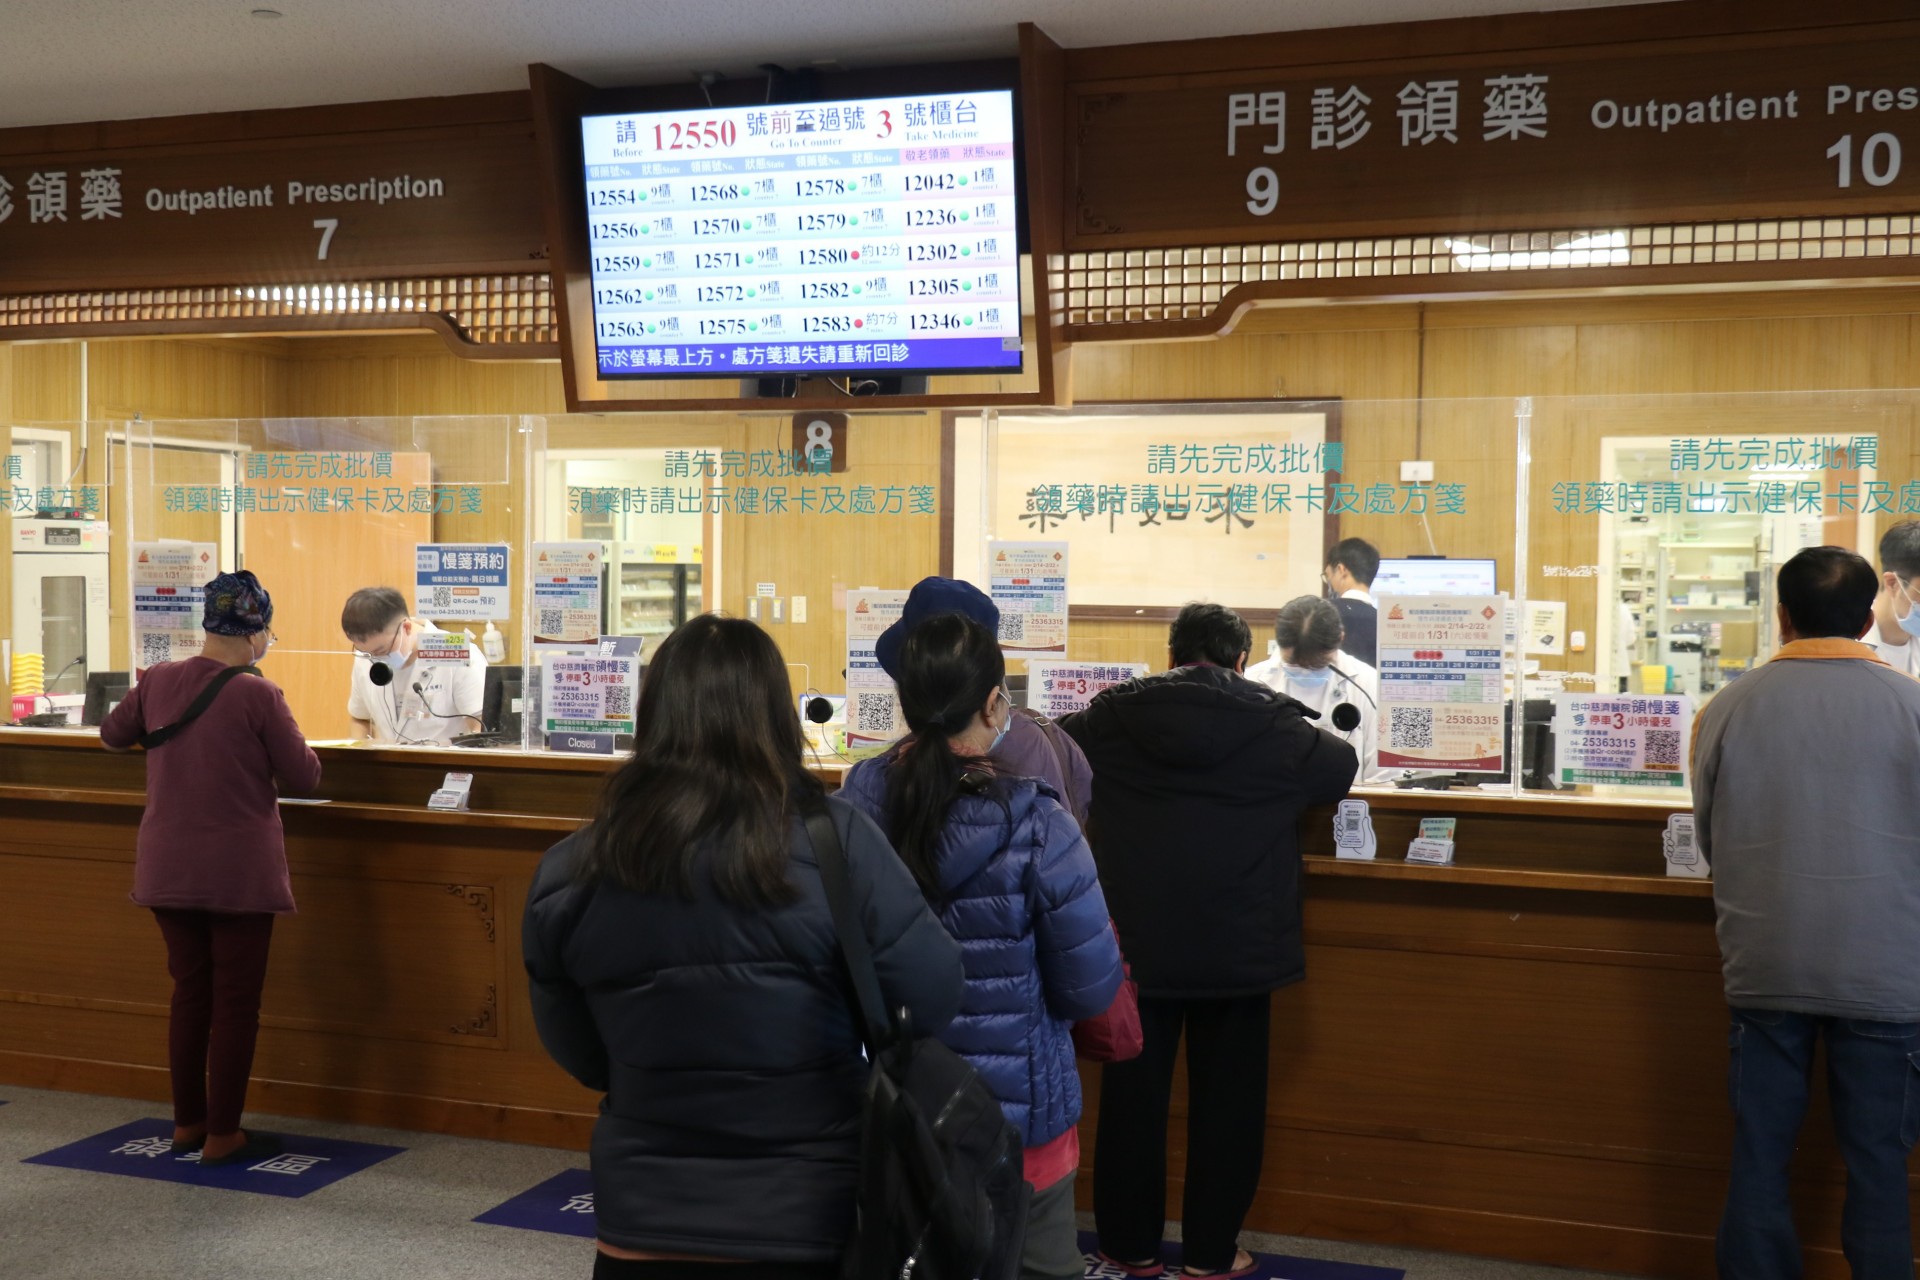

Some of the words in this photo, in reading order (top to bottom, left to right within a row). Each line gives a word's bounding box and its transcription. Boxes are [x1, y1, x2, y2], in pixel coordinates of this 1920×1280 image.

[1227, 73, 1549, 156] 門診領藥
[1590, 89, 1799, 132] Outpatient
[1826, 84, 1918, 115] Pres
[616, 120, 636, 144] 請
[652, 119, 736, 151] 12550
[747, 106, 866, 136] 號前至過號
[876, 110, 892, 138] 3
[904, 99, 977, 127] 號櫃台
[612, 148, 643, 158] Before
[770, 139, 784, 149] Go
[789, 138, 800, 148] To
[802, 137, 842, 148] Counter
[904, 131, 929, 142] Take
[932, 129, 979, 140] Medicine
[904, 148, 950, 161] 敬老領藥
[1826, 132, 1901, 188] 10
[145, 184, 273, 215] Outpatient
[288, 174, 444, 206] Prescription
[590, 189, 636, 206] 12554
[651, 184, 671, 198] 9櫃
[691, 184, 738, 202] 12568
[754, 178, 774, 194] 7櫃
[796, 179, 845, 196] 12578
[862, 173, 883, 188] 7櫃
[905, 174, 955, 191] 12042
[974, 167, 994, 183] 1櫃
[1245, 167, 1280, 216] 9
[592, 223, 638, 239] 12556
[653, 217, 673, 232] 7櫃
[693, 218, 740, 235] 12570
[756, 213, 776, 227] 7櫃
[797, 213, 846, 231] 12579
[863, 208, 884, 223] 7櫃
[906, 209, 956, 226] 12236
[975, 203, 996, 218] 1櫃
[312, 219, 339, 260] 7
[595, 256, 640, 273] 12559
[655, 251, 675, 265] 7櫃
[695, 253, 740, 269] 12571
[758, 247, 778, 261] 9櫃
[799, 248, 847, 265] 12580
[862, 243, 899, 257] 約12分
[907, 244, 957, 261] 12302
[977, 239, 997, 254] 1櫃
[597, 289, 642, 305] 12562
[657, 284, 677, 298] 9櫃
[697, 286, 743, 302] 12572
[760, 281, 780, 295] 9櫃
[801, 282, 849, 299] 12582
[865, 277, 887, 291] 9櫃
[909, 279, 959, 296] 12305
[978, 273, 998, 288] 1櫃
[600, 322, 644, 337] 12563
[660, 317, 680, 331] 9櫃
[699, 319, 746, 335] 12575
[762, 314, 782, 328] 9櫃
[803, 316, 851, 333] 12583
[866, 312, 898, 325] 約7分
[910, 314, 960, 330] 12346
[979, 308, 999, 323] 1櫃
[804, 420, 833, 464] 8
[1147, 442, 1344, 474] 請先完成批價
[1670, 436, 1878, 471] 請先完成批價
[2, 456, 22, 479] 價
[246, 452, 392, 480] 請先完成批價
[664, 449, 833, 478] 請先完成批價
[164, 486, 482, 513] 領藥時請出示健保卡及處方箋
[568, 484, 936, 516] 領藥時請出示健保卡及處方箋
[1035, 482, 1466, 516] 領藥時請出示健保卡及處方箋
[1552, 480, 1920, 514] 領藥時請出示健保卡及處
[442, 553, 504, 570] 慢箋預約
[480, 596, 496, 605] 預約
[1427, 631, 1448, 639] 1/31
[561, 693, 599, 701] 25363315
[1051, 702, 1090, 710] 2536331
[1446, 715, 1499, 725] 25363315
[568, 737, 595, 748] Closed
[1582, 738, 1636, 748] 25363315
[110, 1136, 330, 1175] 領區
